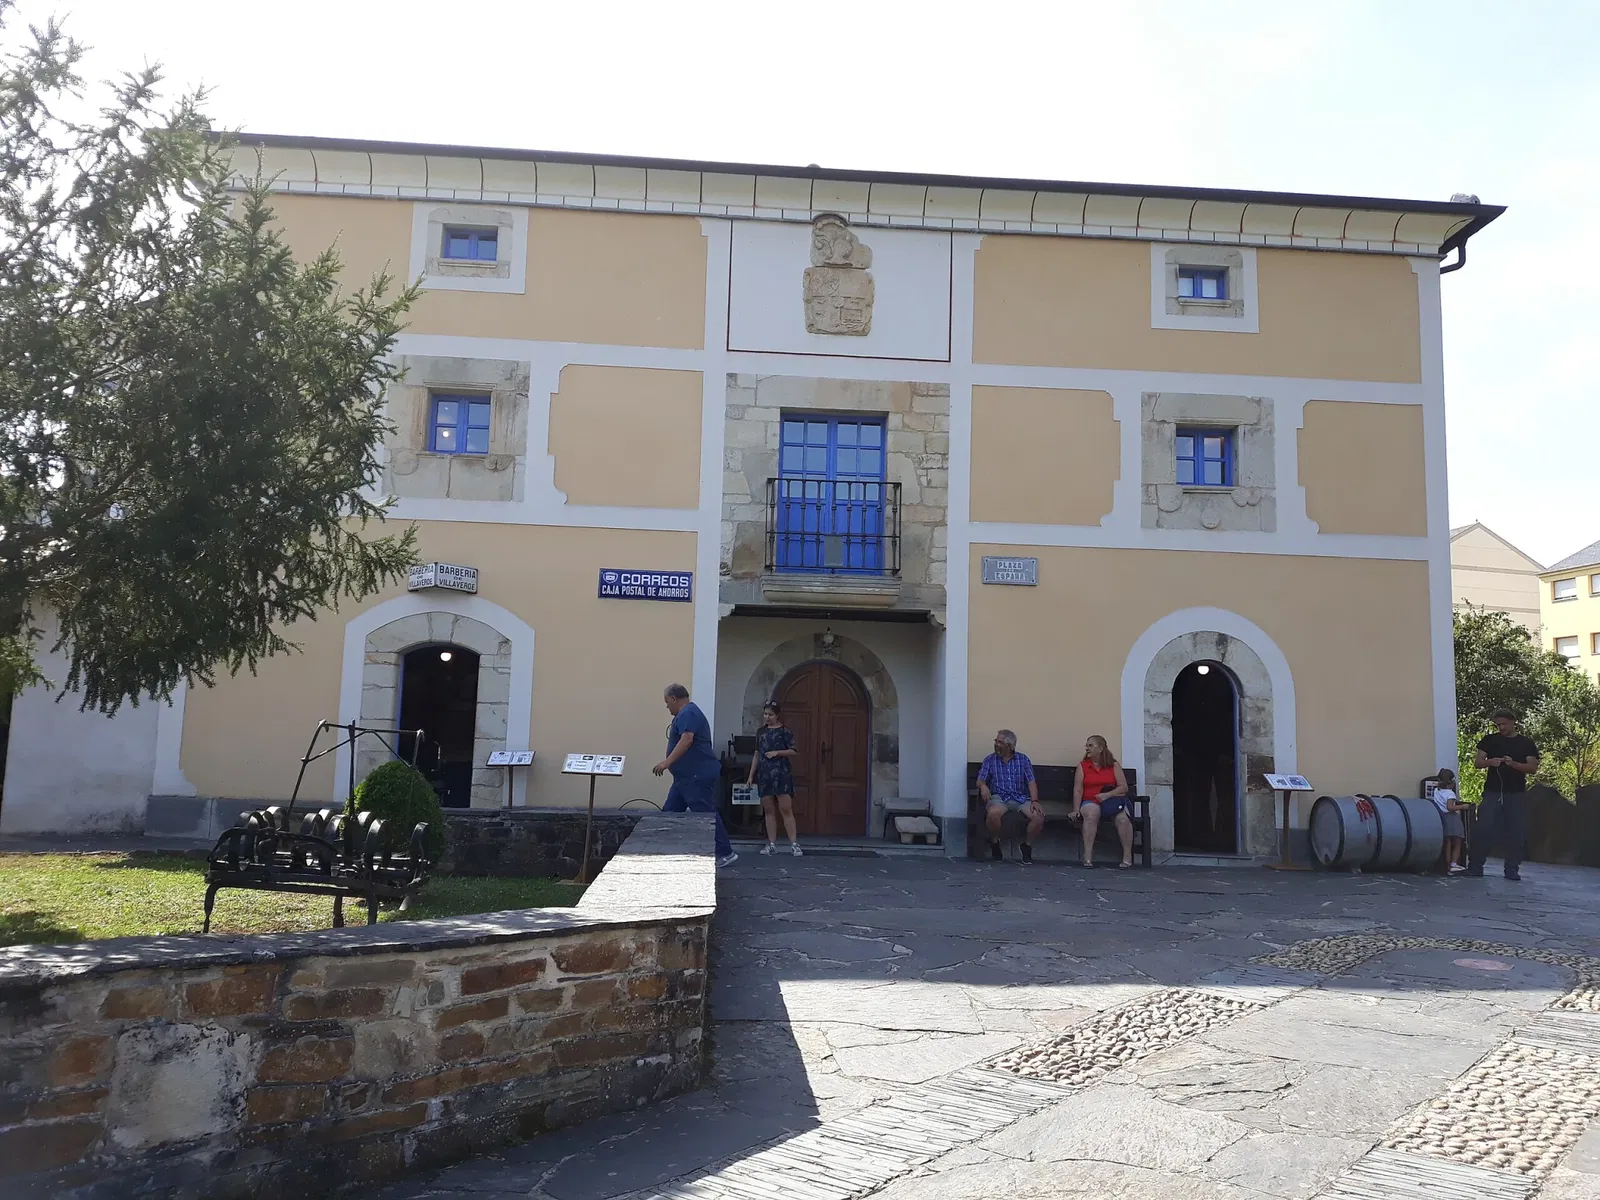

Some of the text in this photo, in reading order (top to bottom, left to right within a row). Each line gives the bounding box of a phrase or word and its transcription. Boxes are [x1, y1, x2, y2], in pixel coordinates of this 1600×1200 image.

[440, 565, 476, 578] BARBERIA
[409, 578, 433, 588] VILLAVERDE
[439, 579, 475, 590] VILLAVERDE
[621, 574, 689, 587] CORREOS
[602, 585, 689, 598] CAJA POSTAL DE AHORROS
